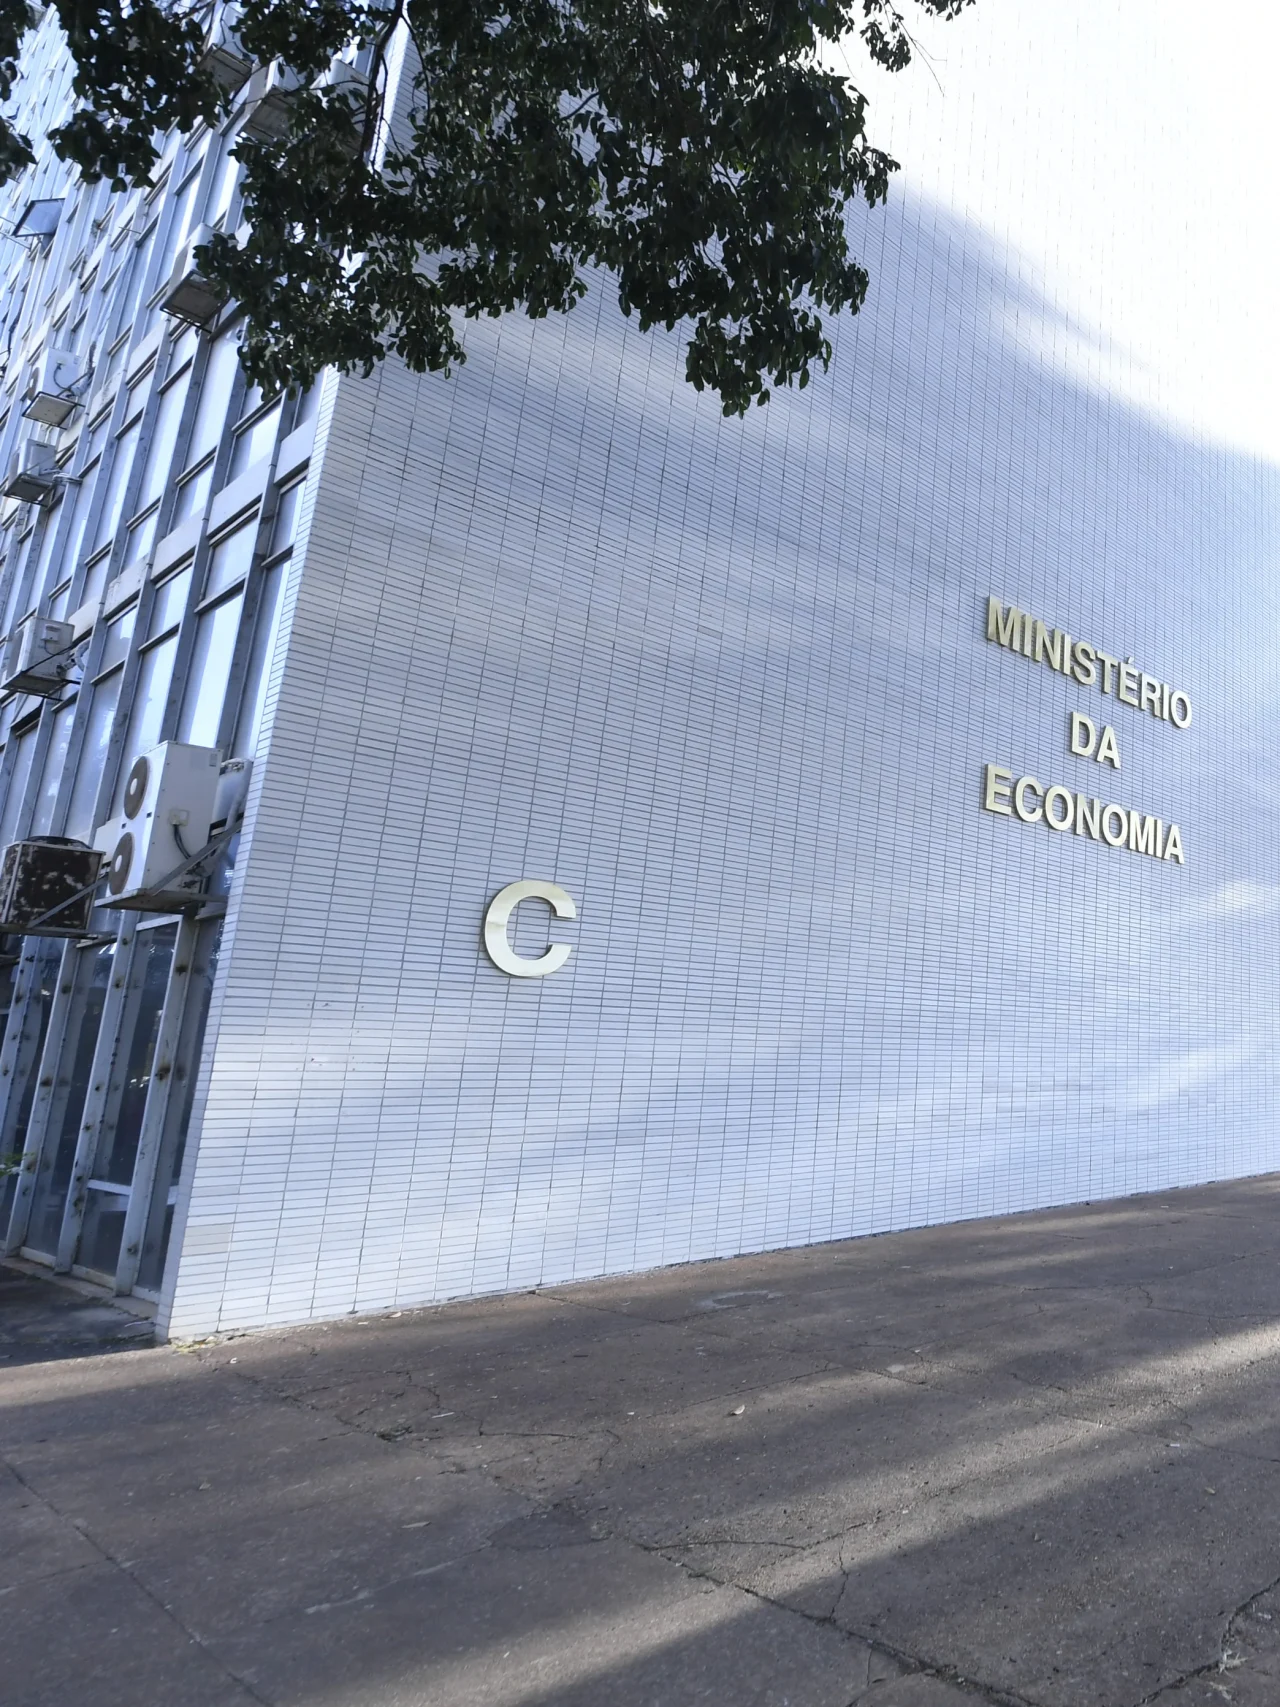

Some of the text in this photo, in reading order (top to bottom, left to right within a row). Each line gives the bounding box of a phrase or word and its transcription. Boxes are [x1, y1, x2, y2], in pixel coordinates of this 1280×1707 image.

[987, 596, 1193, 729] MINISTÉRIO
[1071, 711, 1121, 769] DA
[985, 763, 1185, 864] ECONOMIA
[484, 879, 577, 977] C
